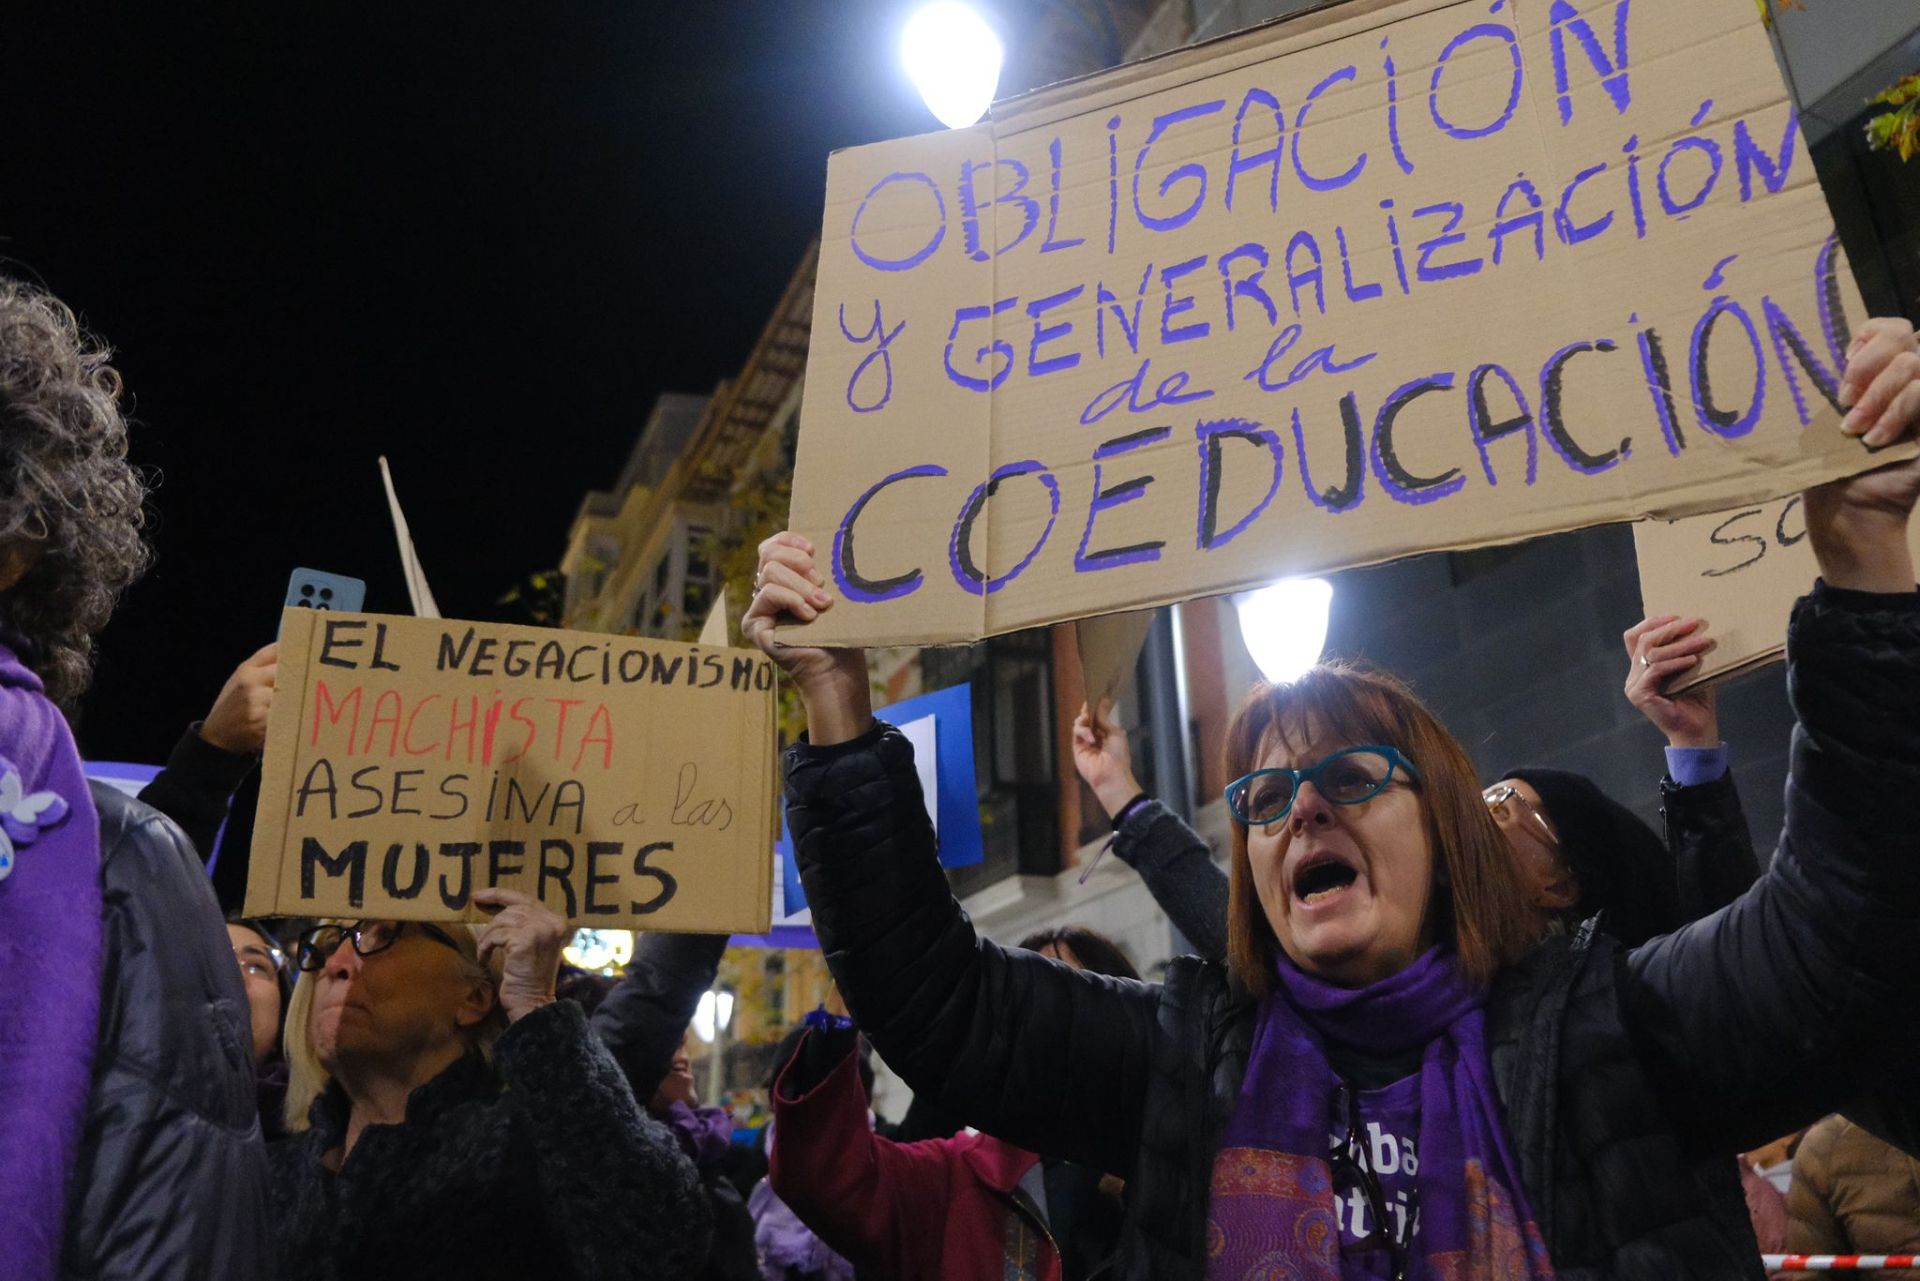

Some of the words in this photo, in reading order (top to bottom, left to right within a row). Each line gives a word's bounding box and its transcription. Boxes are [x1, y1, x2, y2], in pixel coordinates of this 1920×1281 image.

[850, 0, 1631, 272] OBLIGACIÓN
[944, 98, 1798, 392] GENERALIZACIÓN
[1080, 358, 1214, 424] de
[1243, 324, 1377, 392] la
[319, 620, 400, 671] EL
[311, 680, 614, 771] MACHISTA
[296, 759, 586, 834] ASESINA
[613, 799, 645, 826] a
[671, 762, 734, 831] las
[301, 837, 678, 920] MUJERES
